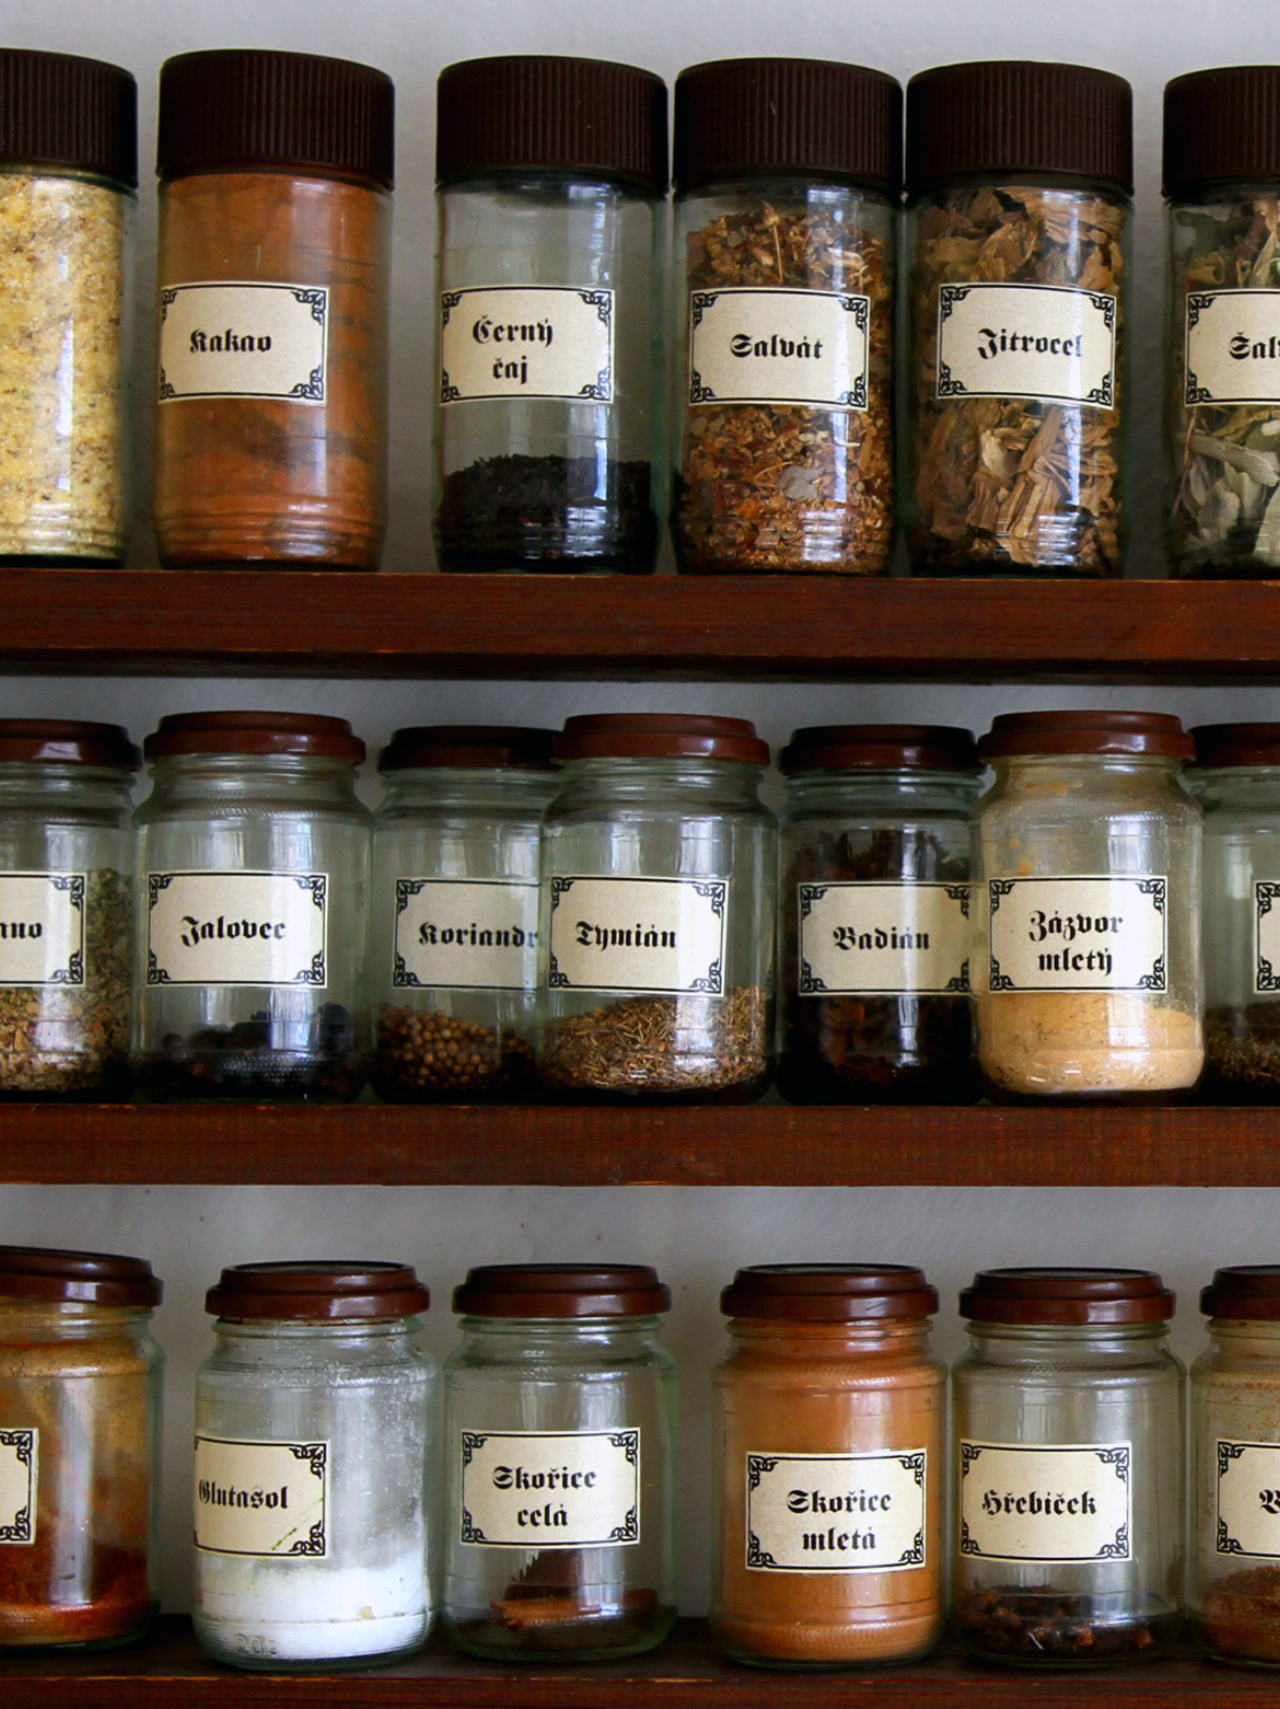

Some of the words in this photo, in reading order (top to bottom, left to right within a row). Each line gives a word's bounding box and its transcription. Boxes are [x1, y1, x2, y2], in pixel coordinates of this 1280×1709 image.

[190, 329, 271, 353] Kakao
[472, 316, 552, 347] Černý
[977, 327, 1083, 360] Jitrocel
[731, 334, 822, 359] Salvát
[493, 356, 527, 384] čaj
[181, 916, 284, 947] Jalovec
[576, 921, 675, 951] Tymián
[833, 927, 929, 950] Badián
[1029, 911, 1122, 941] Zázvor
[1038, 948, 1111, 975] mletý
[493, 1466, 595, 1490] Skořice
[198, 1478, 290, 1510] Glutasol
[787, 1490, 890, 1513] Skořice
[518, 1504, 567, 1527] celá
[802, 1528, 875, 1550] mletá
